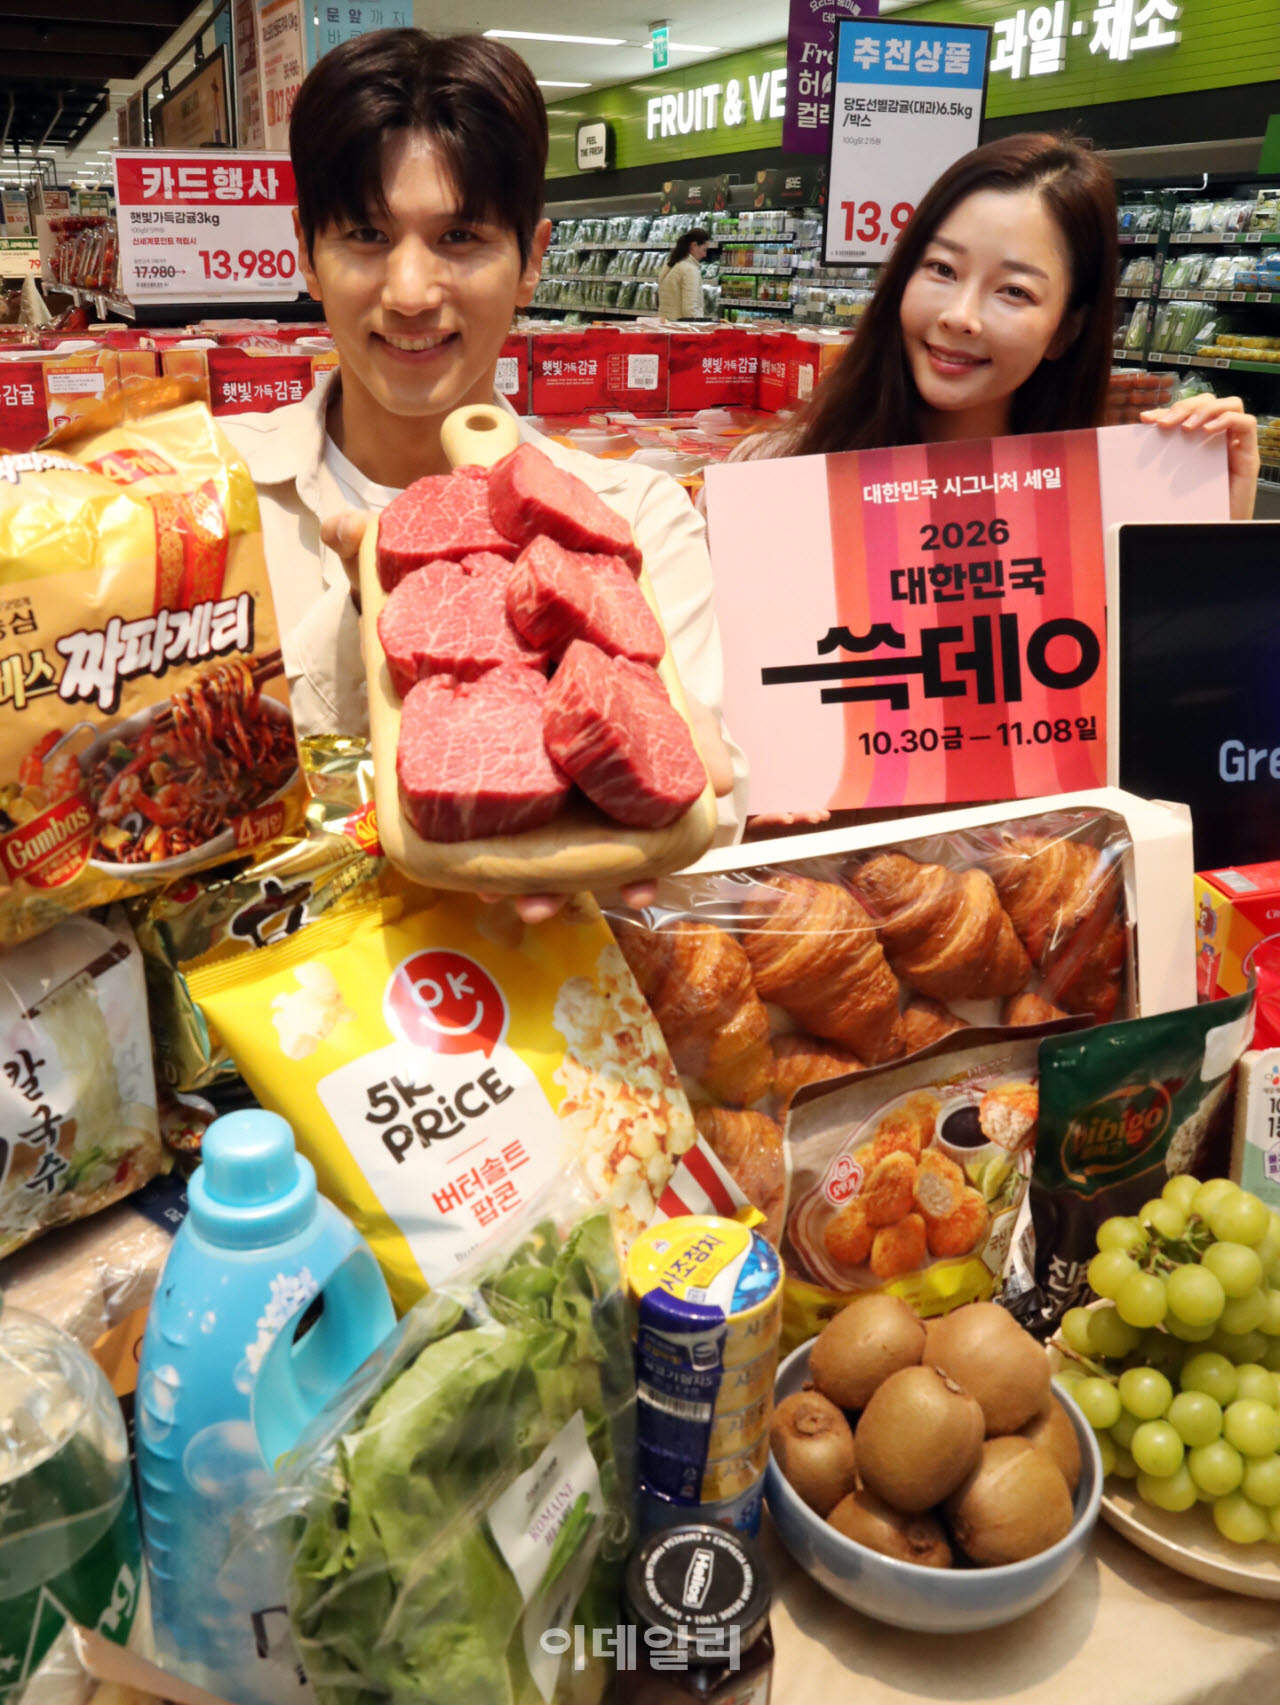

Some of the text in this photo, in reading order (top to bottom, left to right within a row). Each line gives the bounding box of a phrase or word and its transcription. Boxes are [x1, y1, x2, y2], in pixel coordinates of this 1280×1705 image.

[853, 37, 971, 75] 추천상품
[647, 83, 722, 140] FRUIT
[723, 78, 746, 126] &
[843, 113, 871, 127] /박스
[580, 147, 603, 157] THE FRESH
[586, 136, 597, 144] FEEL
[141, 166, 279, 200] 카드행사
[130, 211, 220, 226] 햇빛가득감귤3kg
[132, 237, 175, 245] 신세계포인트
[135, 266, 176, 279] 17,980
[199, 249, 296, 281] 13,980
[542, 360, 562, 376] 햇빛
[578, 359, 598, 376] 감귤
[702, 357, 723, 374] 햇빛
[738, 357, 758, 374] 감귤
[222, 381, 303, 403] 햇빛 가득 감귤
[863, 467, 1062, 504] 대한민국 시그니처 세일
[919, 518, 1010, 551] 2026
[890, 557, 1046, 605] 대한민국
[57, 592, 252, 712] 짜파게티
[6, 805, 91, 870] Gambas
[4, 1049, 69, 1194] 칼국수
[431, 1139, 531, 1215] 버터솔트
[470, 1181, 523, 1227] 팝콘
